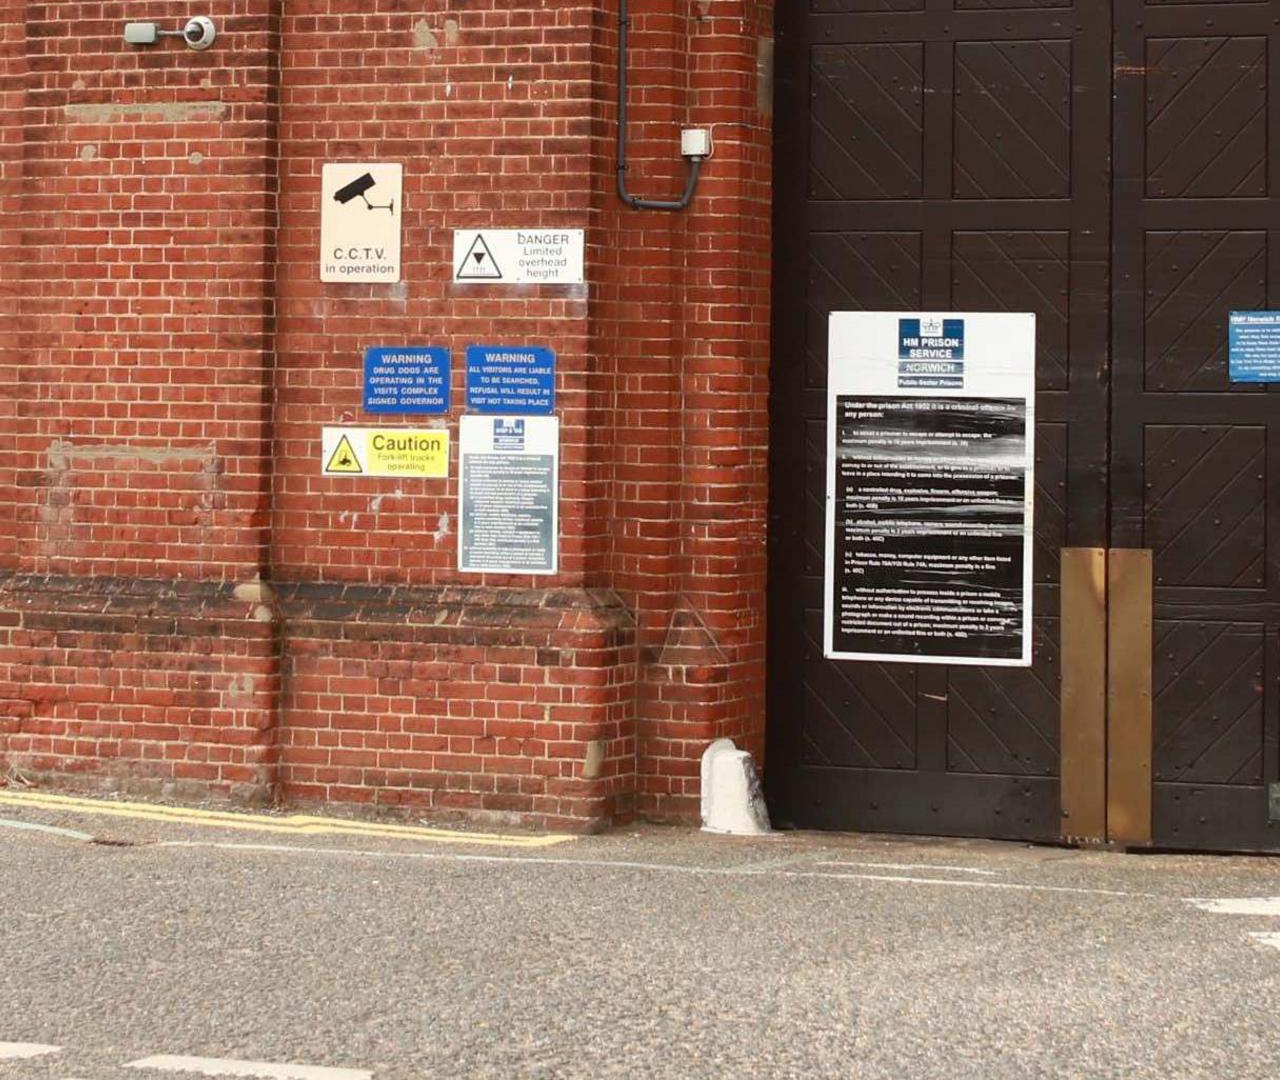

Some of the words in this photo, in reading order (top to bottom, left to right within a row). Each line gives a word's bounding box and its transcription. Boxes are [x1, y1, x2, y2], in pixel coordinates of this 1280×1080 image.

[517, 233, 569, 245] DANGER
[333, 248, 387, 260] C.C.T.V.
[523, 247, 562, 256] Limited
[518, 258, 567, 268] overhead
[325, 263, 336, 273] in
[339, 264, 394, 275] operation
[526, 269, 559, 280] height
[903, 338, 919, 347] HM
[921, 338, 959, 348] PRISON
[485, 353, 536, 363] WARNING
[910, 349, 952, 358] SERVICE
[381, 354, 432, 364] WARNING
[906, 363, 955, 372] NORWICH
[401, 387, 438, 395] COMPLEX
[372, 435, 441, 451] Caution
[410, 453, 435, 462] trucks
[387, 464, 425, 472] operating
